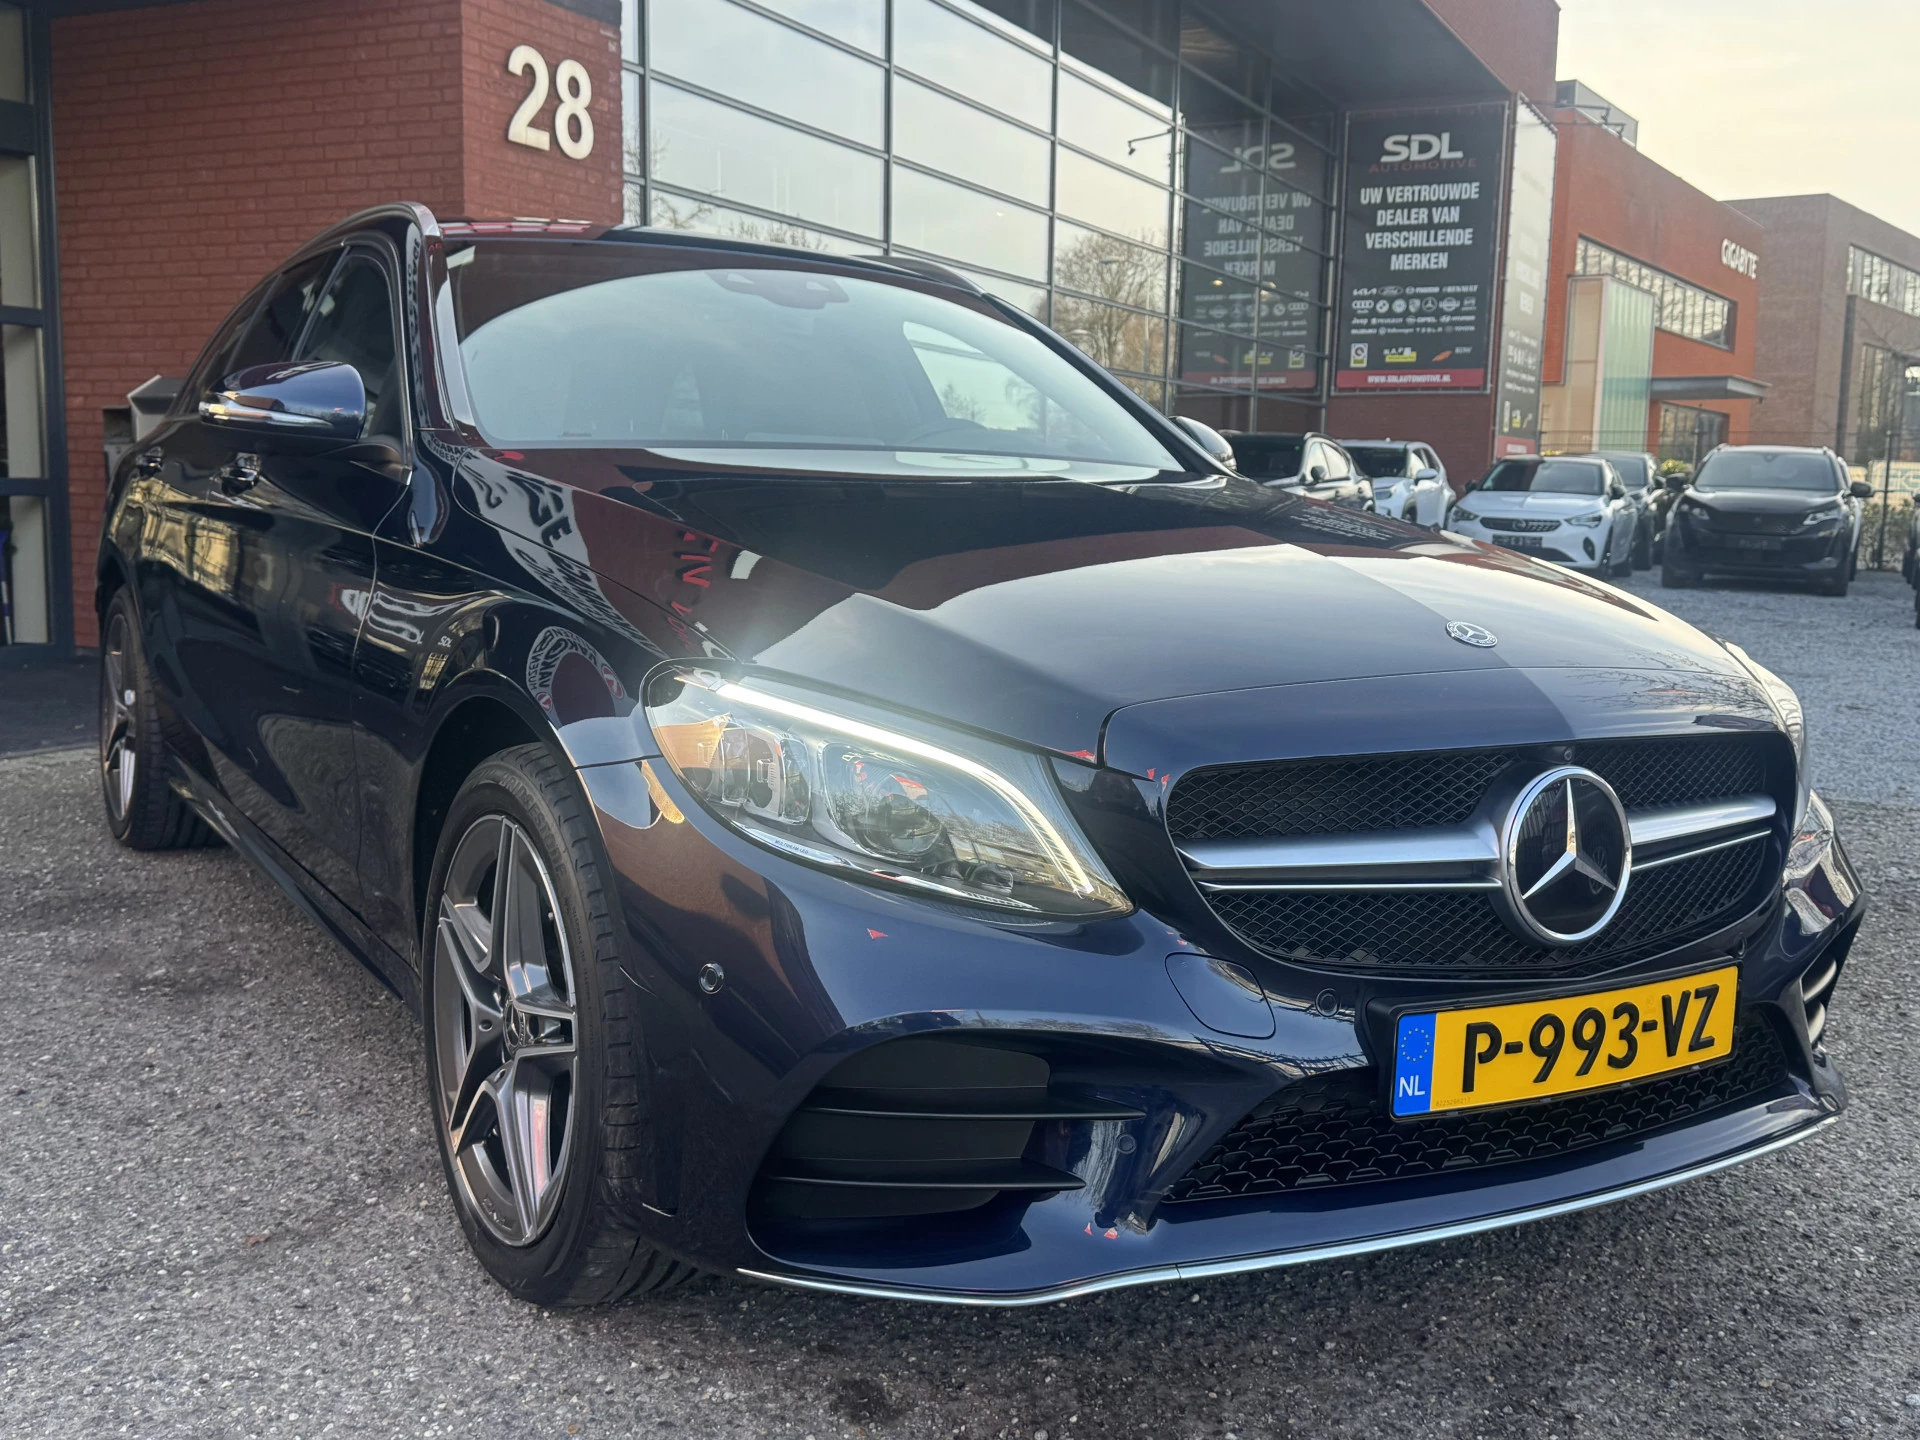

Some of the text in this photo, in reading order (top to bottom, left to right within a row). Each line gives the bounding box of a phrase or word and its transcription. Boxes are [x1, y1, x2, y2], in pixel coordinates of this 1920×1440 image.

[507, 45, 595, 160] 28
[1380, 132, 1464, 163] SDL
[1368, 158, 1477, 174] AUTOMOTIVE
[1360, 182, 1480, 205] UW VERTROUWDE
[1376, 206, 1460, 226] DEALER VAN
[1365, 228, 1474, 249] VERSCHILLENDE
[1390, 252, 1449, 271] MERKEN
[1721, 238, 1760, 280] GIGABYTE
[1461, 983, 1720, 1093] P-993-VZ
[1398, 1076, 1426, 1098] NL
